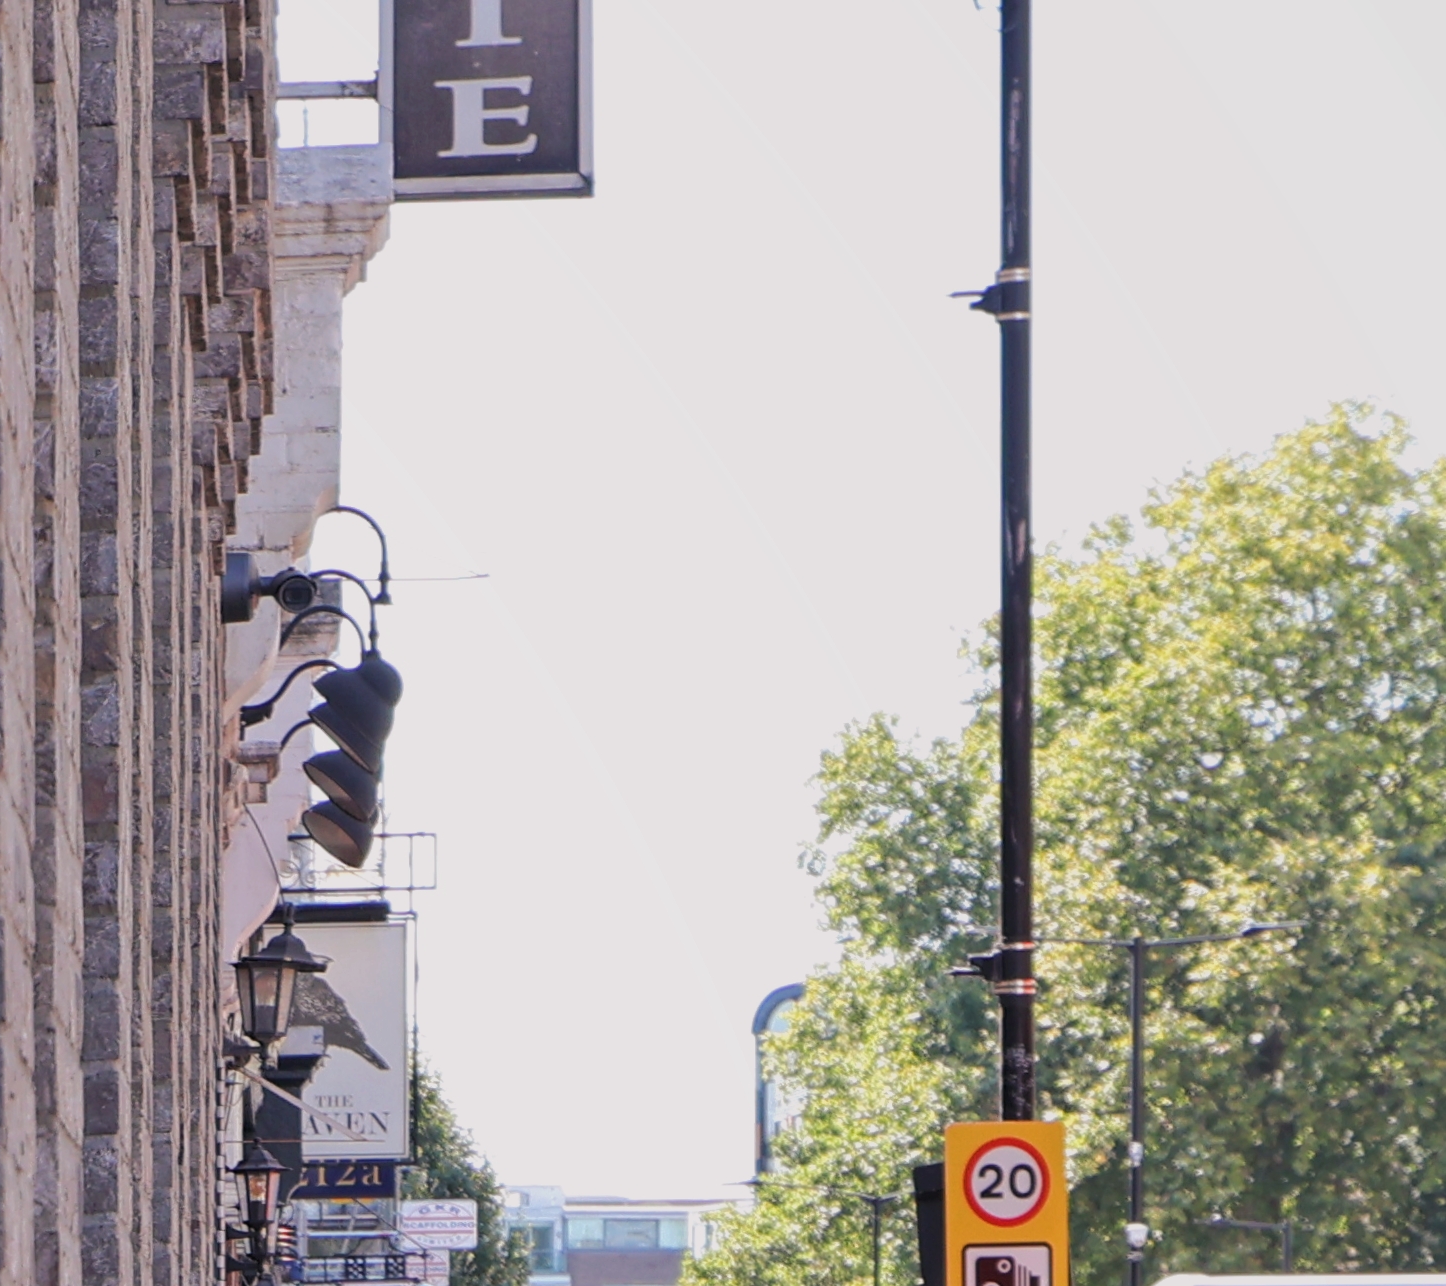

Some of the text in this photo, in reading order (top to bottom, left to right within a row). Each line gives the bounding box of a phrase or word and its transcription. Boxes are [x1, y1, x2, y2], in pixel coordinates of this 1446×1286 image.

[315, 1095, 353, 1108] THE
[303, 1111, 390, 1135] AVEN
[978, 1164, 1036, 1199] 20
[403, 1221, 475, 1229] SCAFFOLDING
